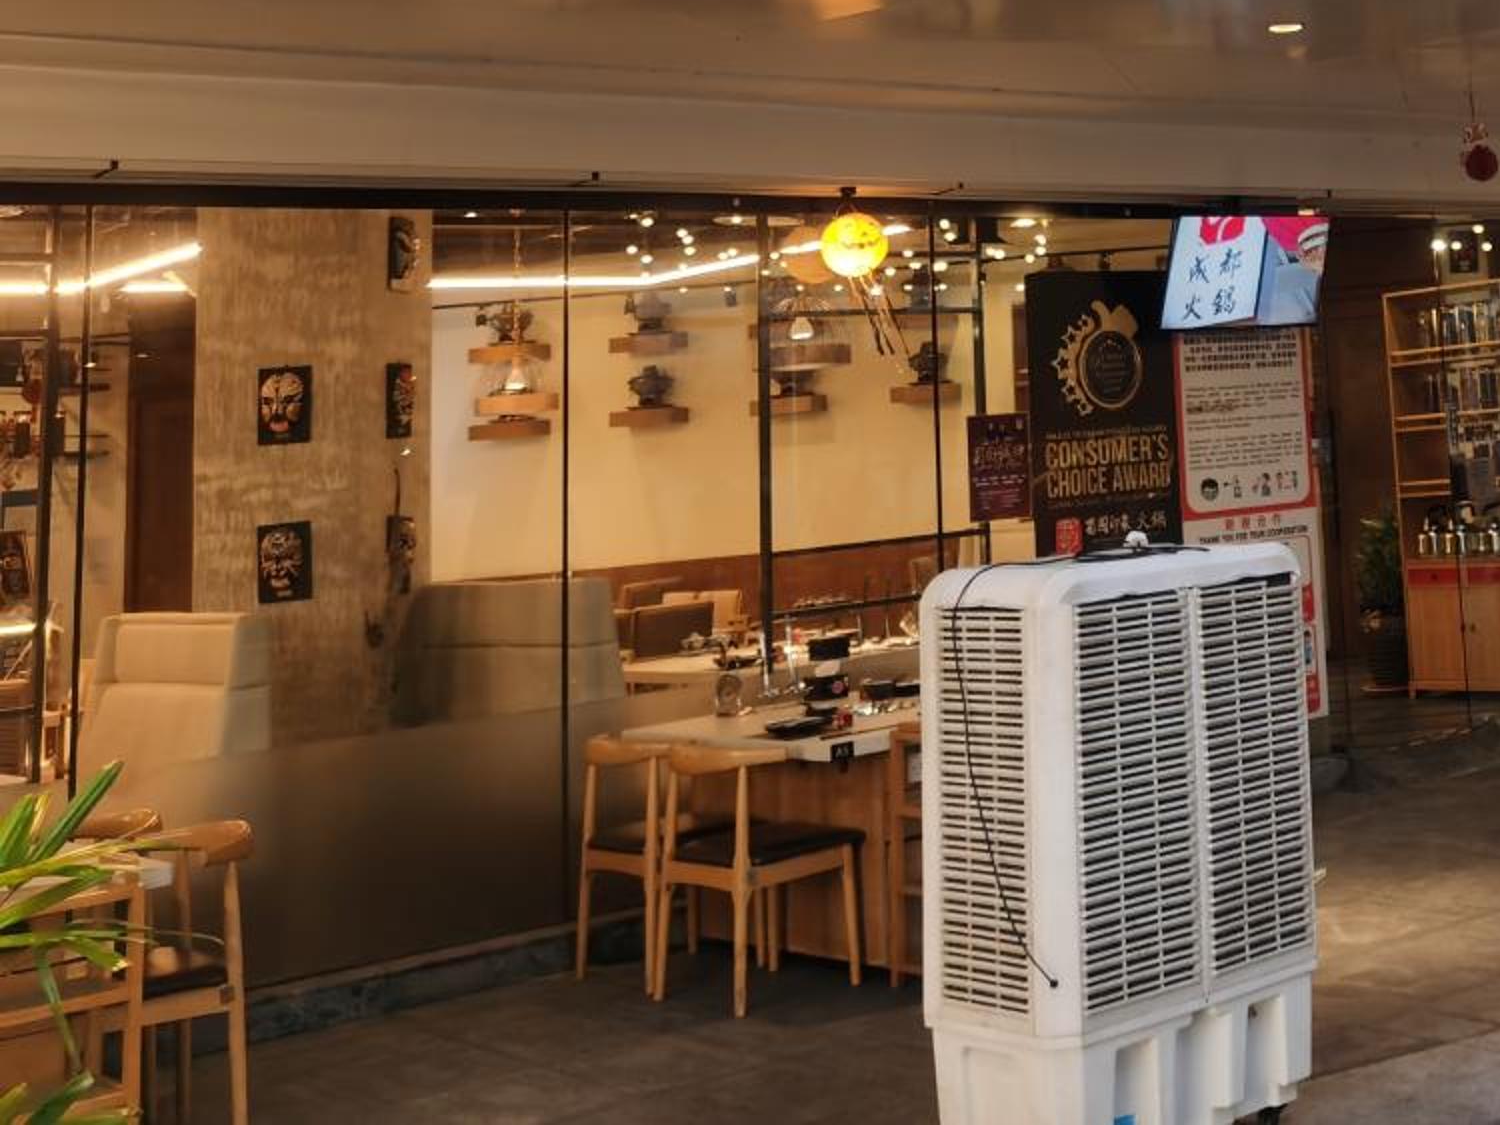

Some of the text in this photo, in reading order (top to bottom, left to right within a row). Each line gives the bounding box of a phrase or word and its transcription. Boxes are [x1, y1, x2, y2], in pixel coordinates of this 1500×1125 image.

[1045, 433, 1169, 469] CONSUMER'S
[1046, 466, 1108, 499] CHOICE
[1112, 461, 1171, 492] AWARD
